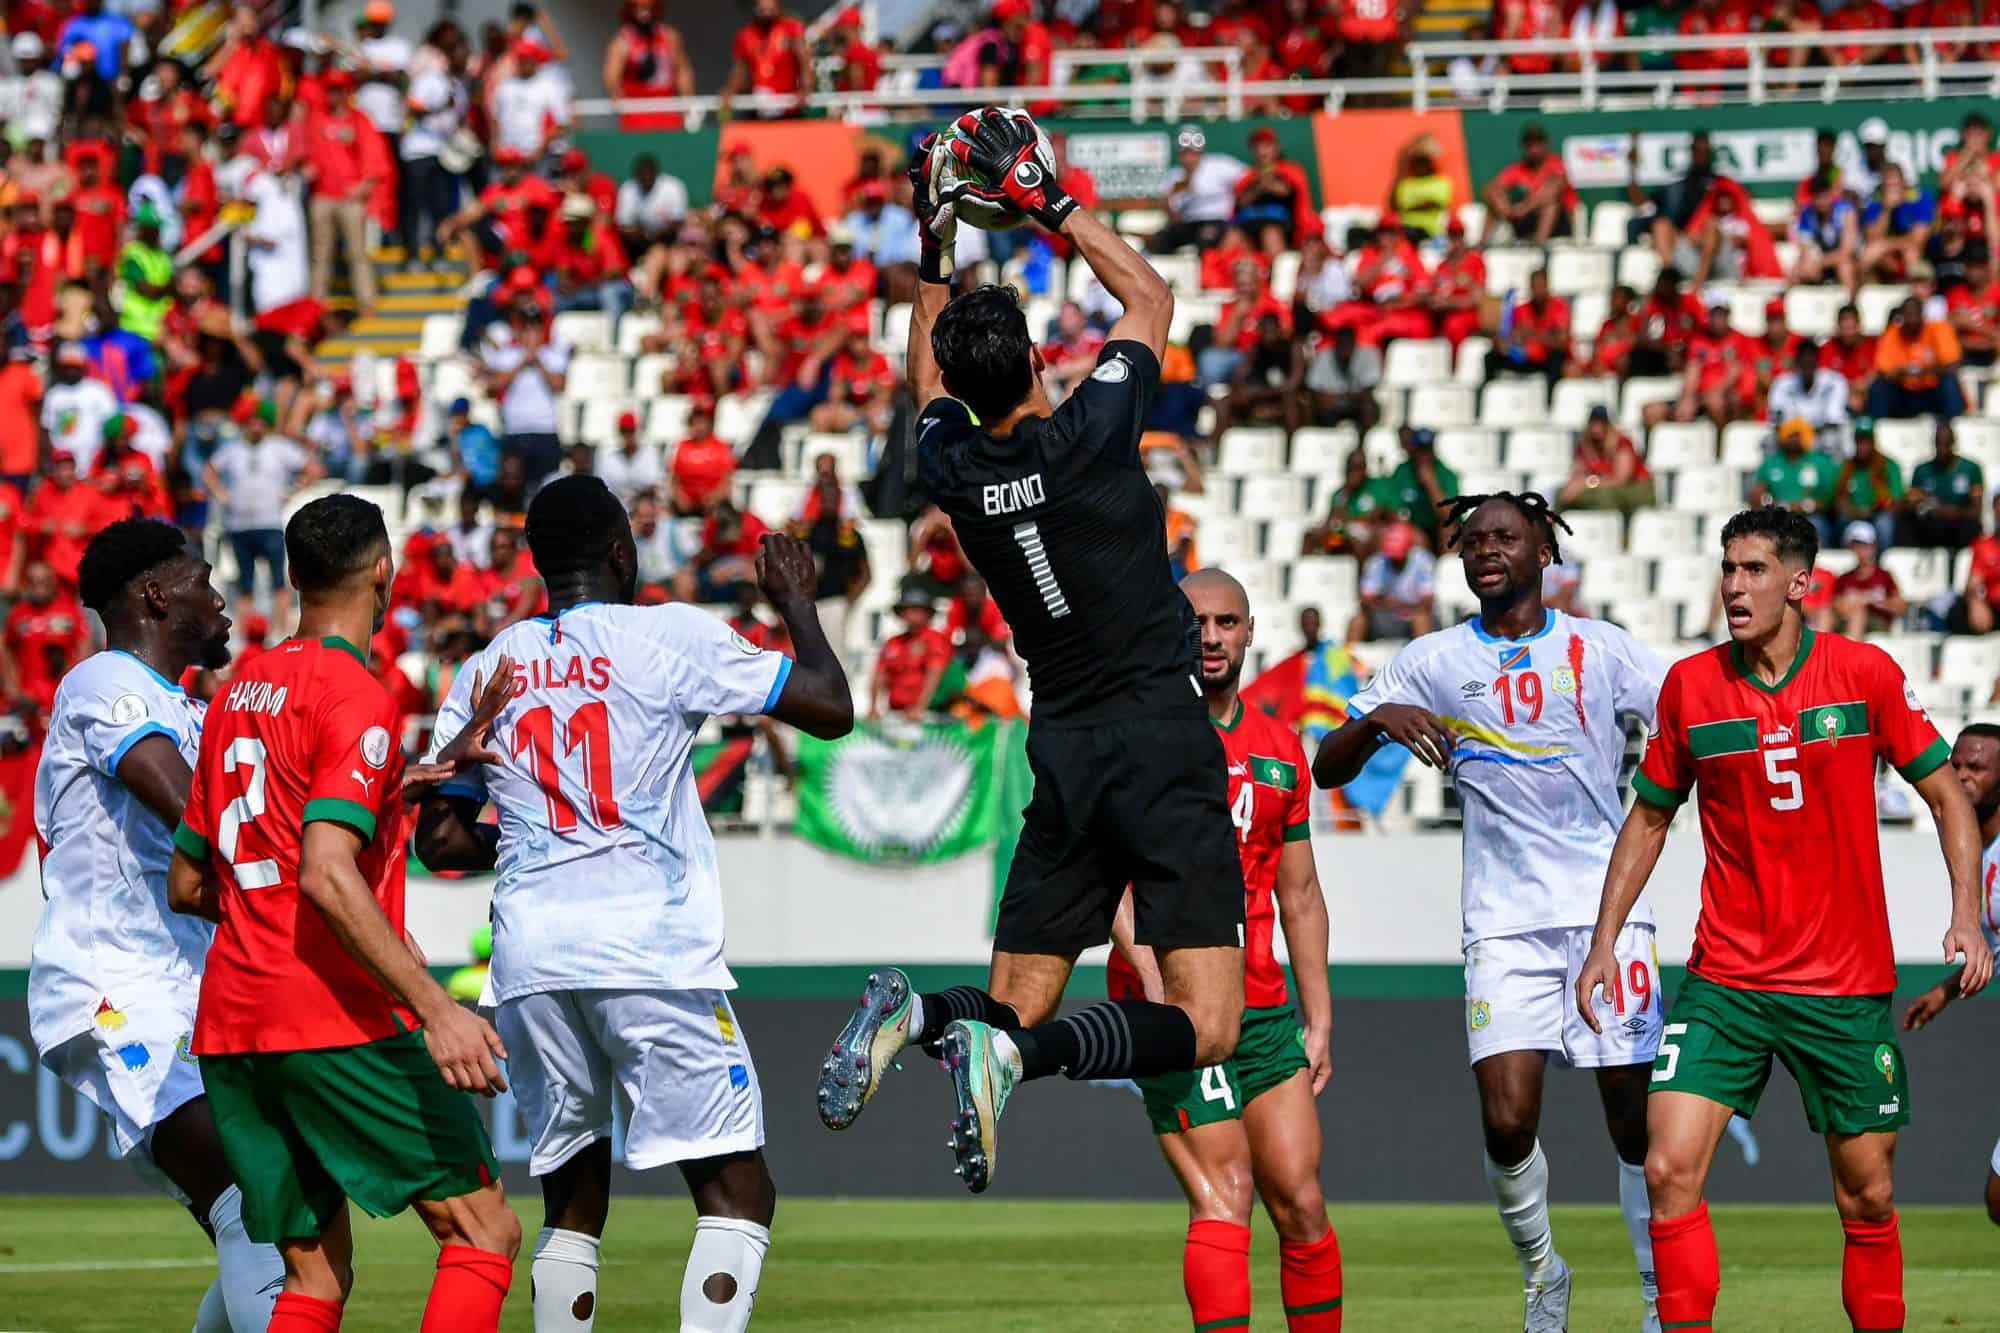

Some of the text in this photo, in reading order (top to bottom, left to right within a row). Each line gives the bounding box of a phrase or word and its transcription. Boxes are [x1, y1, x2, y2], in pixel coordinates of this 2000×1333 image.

[984, 473, 1046, 516] BONO
[1013, 521, 1072, 619] 1
[224, 680, 288, 718] HAKIMI
[511, 655, 612, 699] SILAS
[1492, 671, 1544, 728] 19
[510, 700, 625, 836] 11
[1763, 747, 1804, 811] 5
[218, 736, 282, 890] 2
[1231, 781, 1254, 844] 4
[1613, 959, 1651, 1017] 19
[1651, 1022, 1688, 1083] 5
[1200, 1063, 1236, 1112] 4
